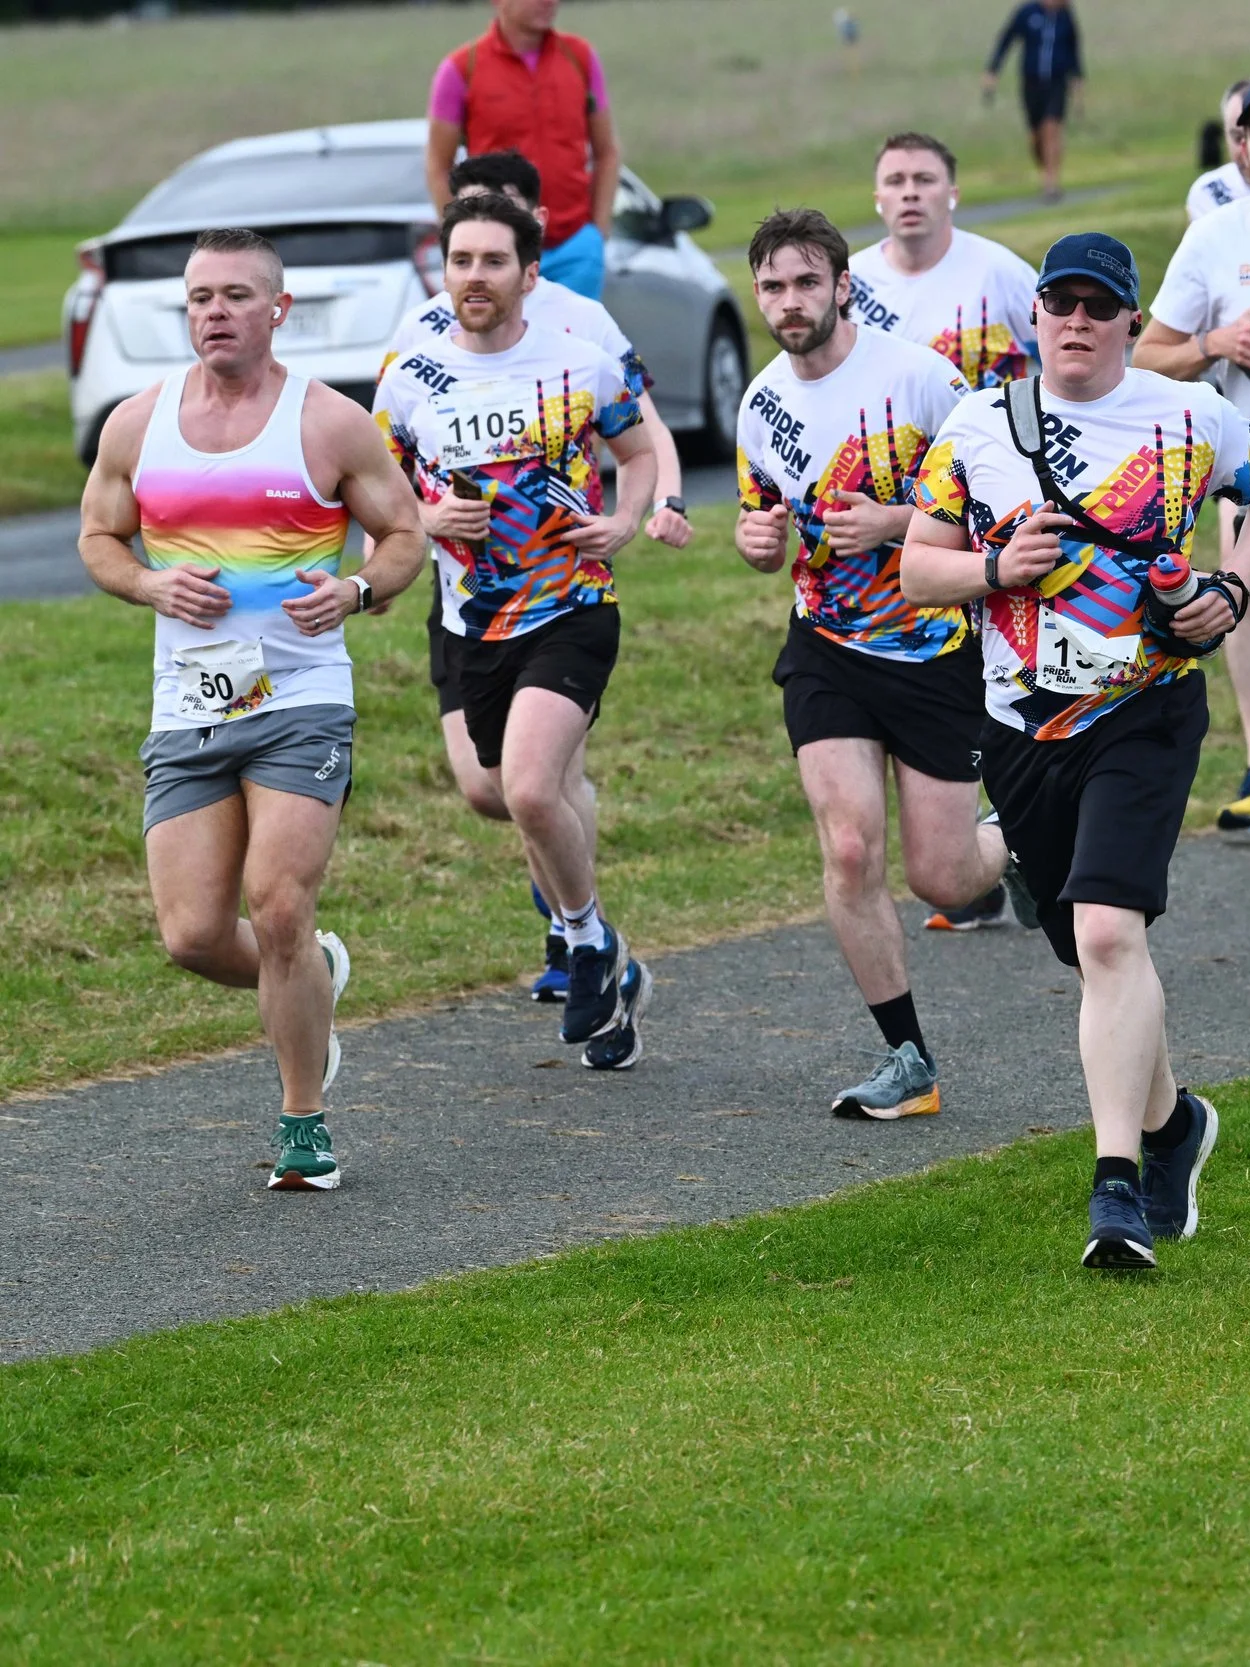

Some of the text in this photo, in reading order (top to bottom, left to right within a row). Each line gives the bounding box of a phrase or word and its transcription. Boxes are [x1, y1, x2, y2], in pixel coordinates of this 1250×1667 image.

[400, 358, 459, 394] PRID
[761, 386, 782, 403] DUBLIN
[448, 409, 526, 443] 1105
[749, 391, 805, 444] PRIDE
[770, 430, 812, 474] RUN
[826, 434, 862, 494] PRIDE
[1042, 439, 1089, 480] UN
[784, 466, 801, 481] 2024
[1051, 470, 1070, 488] 024
[1098, 445, 1157, 510] PRIDE
[200, 672, 234, 700] 50
[1043, 667, 1070, 677] PRIDE
[1056, 675, 1077, 684] RUN
[182, 695, 202, 704] PRID
[314, 746, 340, 781] ECHT
